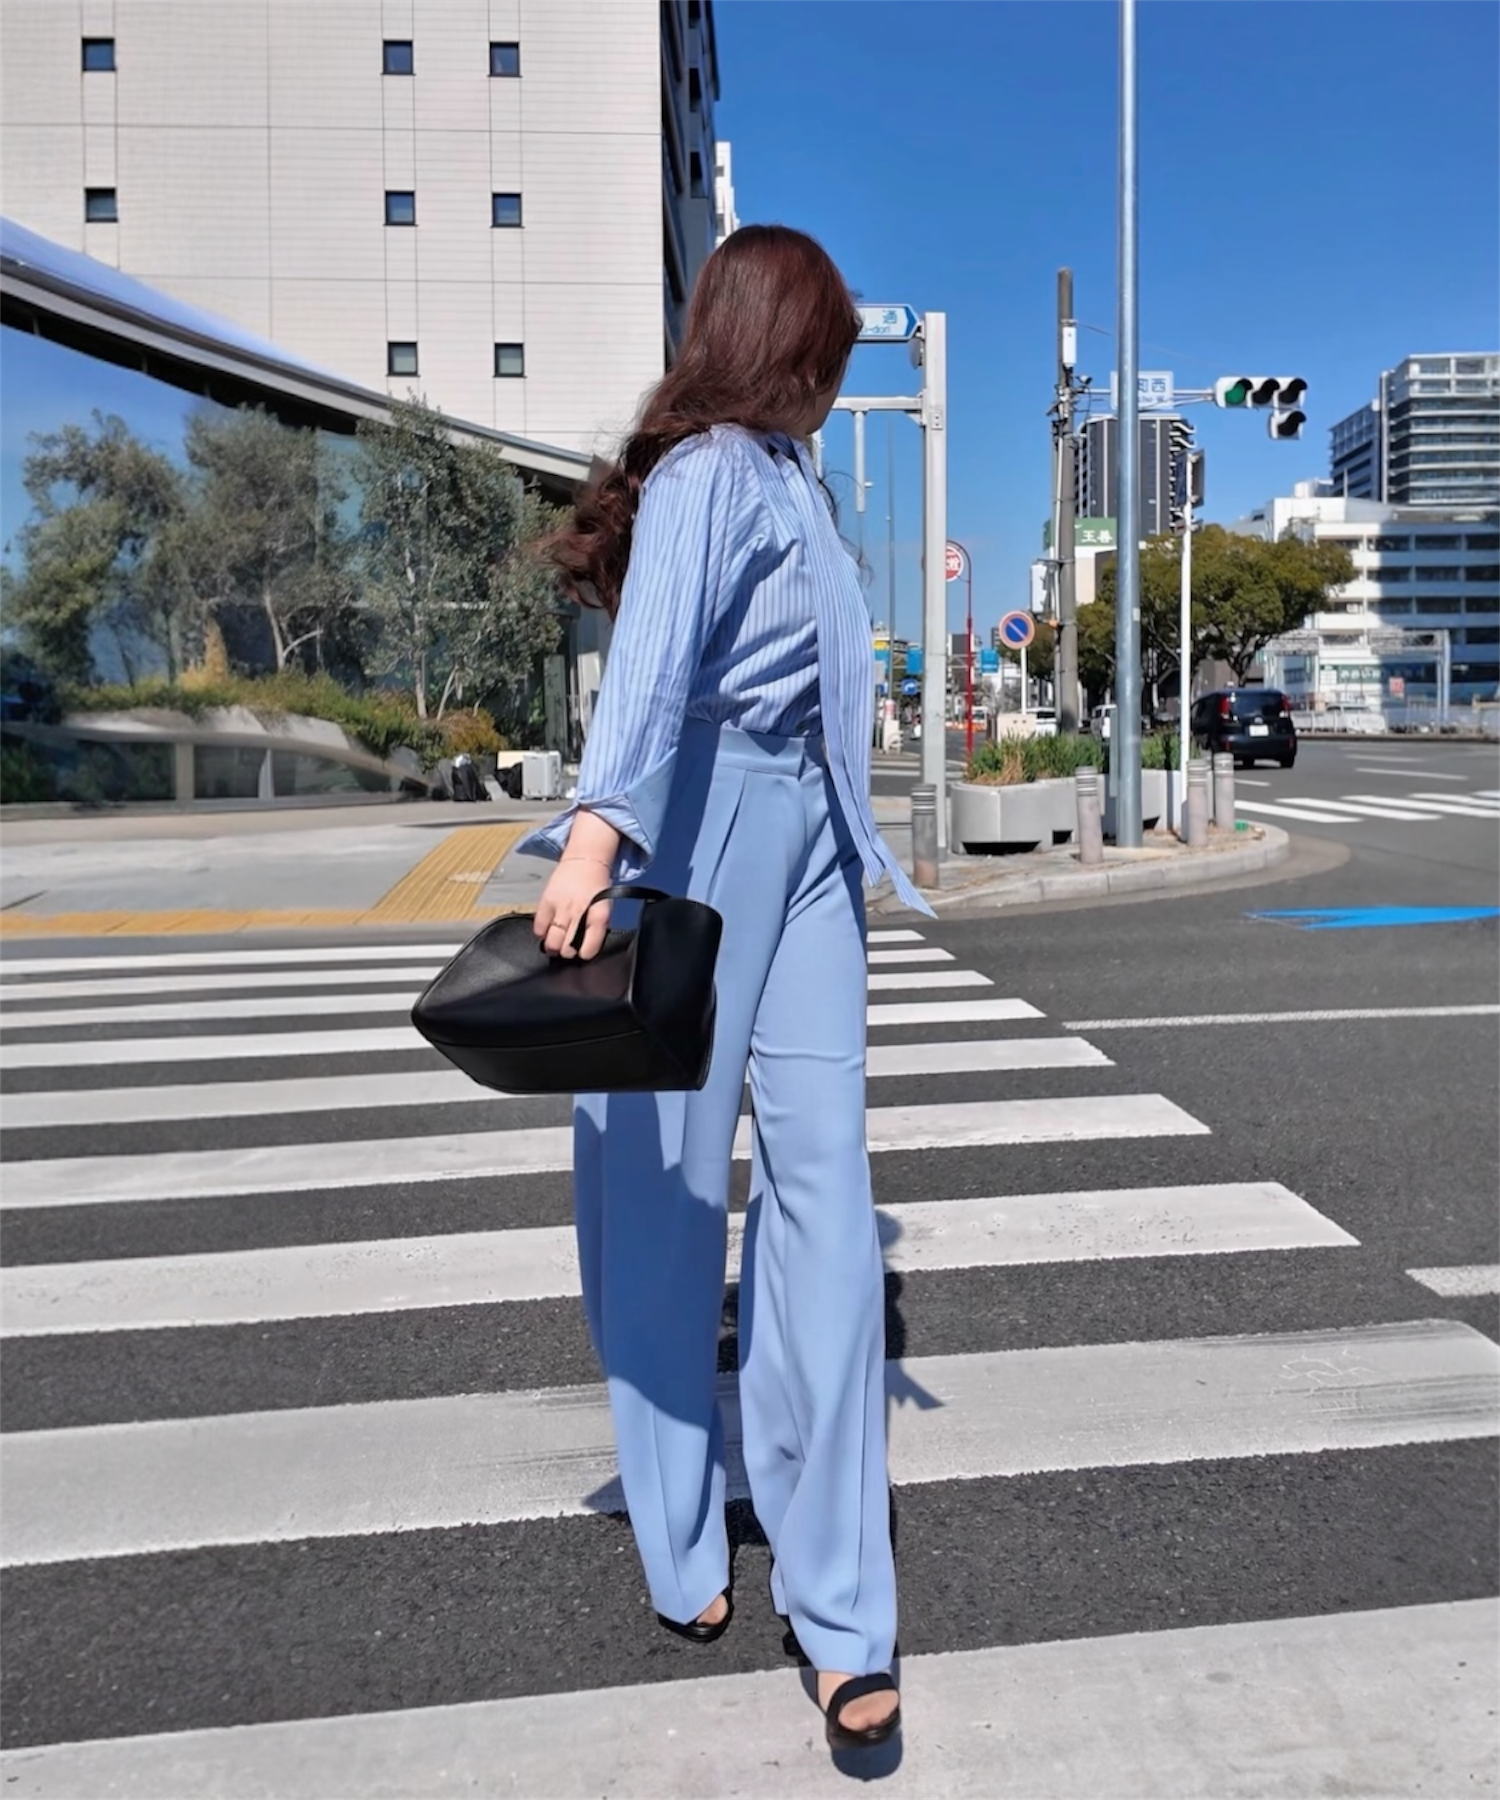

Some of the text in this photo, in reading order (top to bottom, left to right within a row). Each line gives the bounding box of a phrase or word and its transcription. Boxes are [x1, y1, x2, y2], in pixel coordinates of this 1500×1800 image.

[882, 310, 898, 325] 通
[862, 325, 891, 334] i-dori
[1137, 378, 1167, 393] 町西
